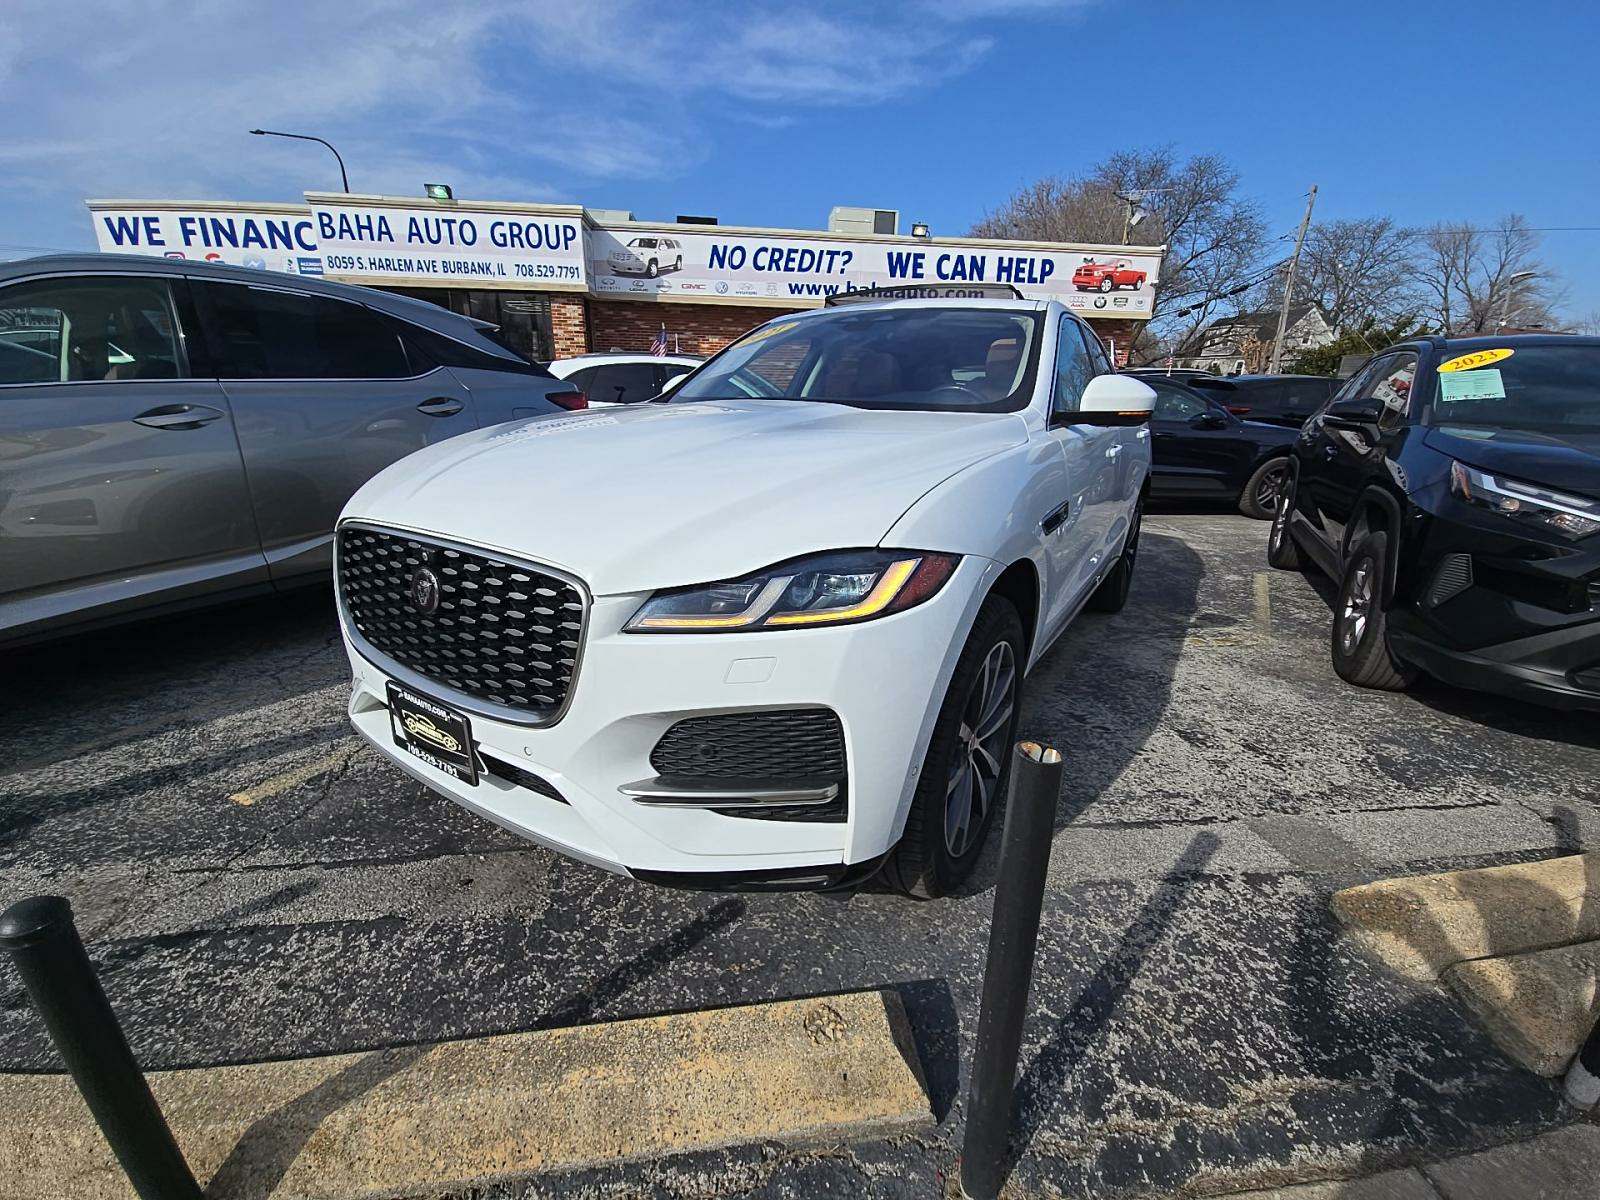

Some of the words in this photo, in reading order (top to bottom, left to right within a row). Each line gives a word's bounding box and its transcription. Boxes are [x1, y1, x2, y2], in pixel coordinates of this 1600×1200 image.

[104, 217, 165, 246] WE
[318, 212, 394, 242] BAHA
[408, 217, 477, 246] AUTO
[490, 222, 577, 250] GROUP
[327, 255, 355, 269] 8059
[357, 257, 367, 270] S.
[368, 257, 415, 272] HARLEM
[416, 260, 438, 273] AVE
[442, 261, 496, 277] BURBANK,
[497, 263, 507, 276] IL
[514, 264, 580, 279] 708.529.7791
[708, 244, 746, 270] NO
[753, 246, 854, 274] CREDIT?
[887, 251, 926, 279] WE
[936, 254, 986, 282] CAN
[996, 256, 1055, 284] HELP
[788, 281, 985, 299] wwwbahaauto.com
[1450, 350, 1498, 370] 2023
